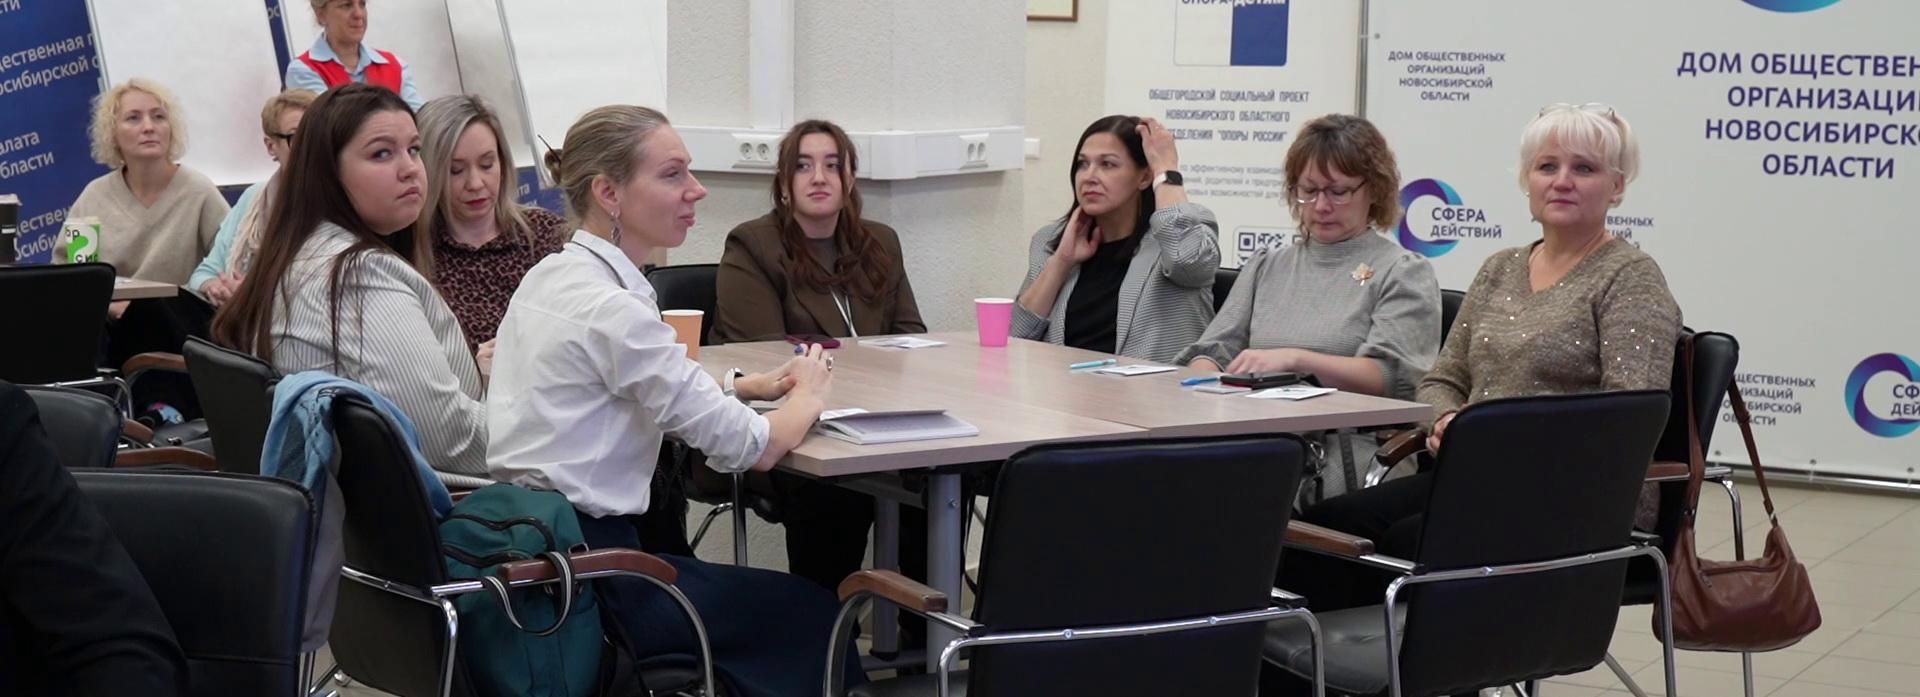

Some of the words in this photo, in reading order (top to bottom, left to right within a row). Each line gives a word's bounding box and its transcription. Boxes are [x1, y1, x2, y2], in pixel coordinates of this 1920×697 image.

[0, 0, 20, 14] ти
[1388, 51, 1413, 62] ДОМ
[1416, 51, 1505, 62] ОБЩЕСТВЕННЫХ
[1407, 64, 1485, 76] ОРГАНИЗАЦИЙ
[1677, 52, 1742, 78] ДОМ
[1399, 77, 1493, 89] НОВОСИБИРСКОЙ
[1149, 89, 1216, 101] ОБЩЕГОРОДСКОЙ
[1220, 90, 1275, 102] СОЦИАЛЬНЫЙ
[1280, 91, 1309, 102] ПРОЕКТ
[1420, 91, 1470, 102] ОБЛАСТИ
[1727, 86, 1920, 116] ОРГАНИЗАЦИ
[1166, 109, 1235, 121] НОВОСИБИРСКОГО
[1239, 111, 1290, 122] ОБЛАСТНОГО
[1705, 118, 1920, 146] НОВОСИБИРСК
[1762, 153, 1895, 179] ОБЛАСТИ
[1431, 207, 1486, 223] СФЕРА
[1430, 223, 1503, 239] ДЕЙСТВИЙ
